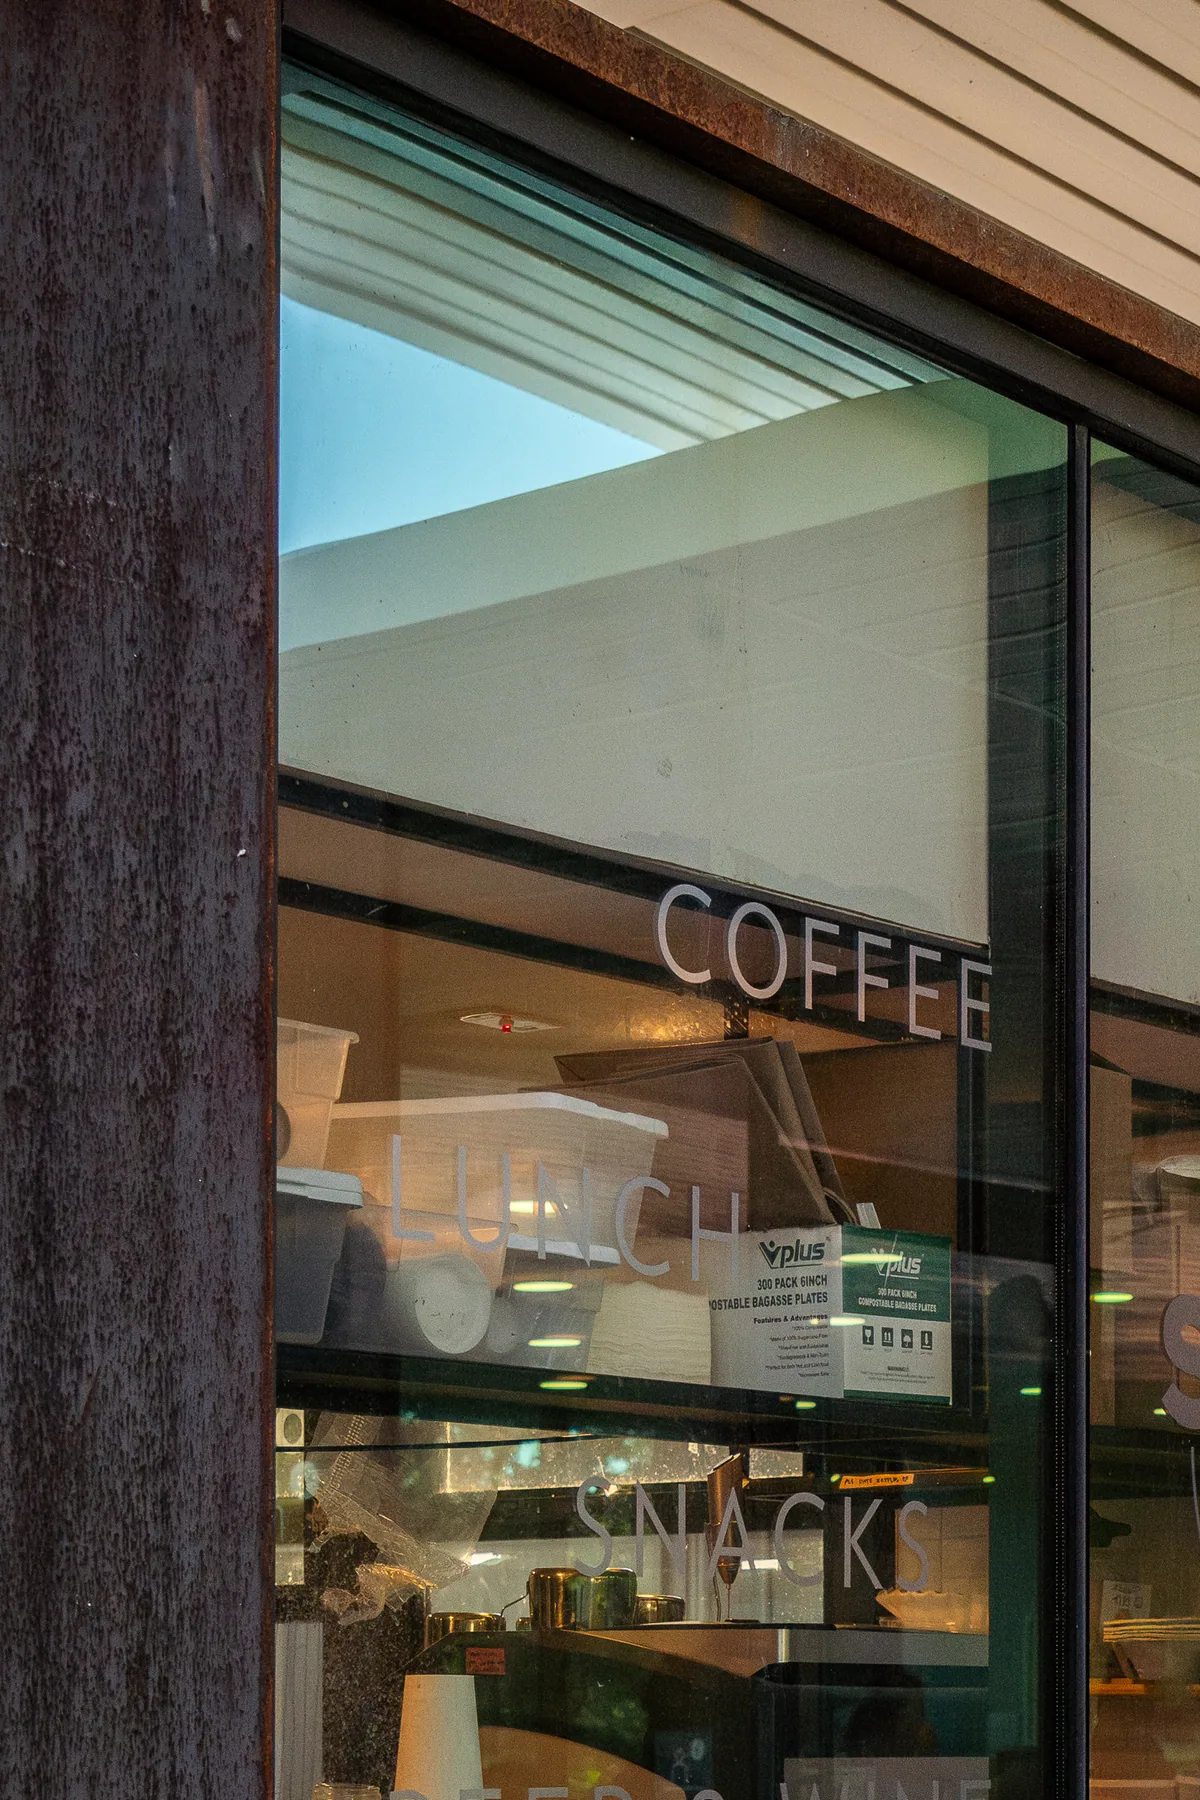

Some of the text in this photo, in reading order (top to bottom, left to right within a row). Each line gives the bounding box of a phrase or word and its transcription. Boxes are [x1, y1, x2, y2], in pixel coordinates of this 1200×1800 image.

[655, 883, 992, 1053] COFFEE
[390, 1133, 740, 1283] LUNCH
[757, 1274, 828, 1291] 300 PACK 6INCH
[752, 1294, 793, 1308] BAGASSE
[794, 1291, 828, 1305] PLATES
[878, 1288, 887, 1296] 300
[888, 1289, 901, 1297] PACK
[858, 1297, 895, 1308] COMPOSTABLE
[918, 1303, 937, 1312] PLATES
[573, 1475, 929, 1593] SNACKS
